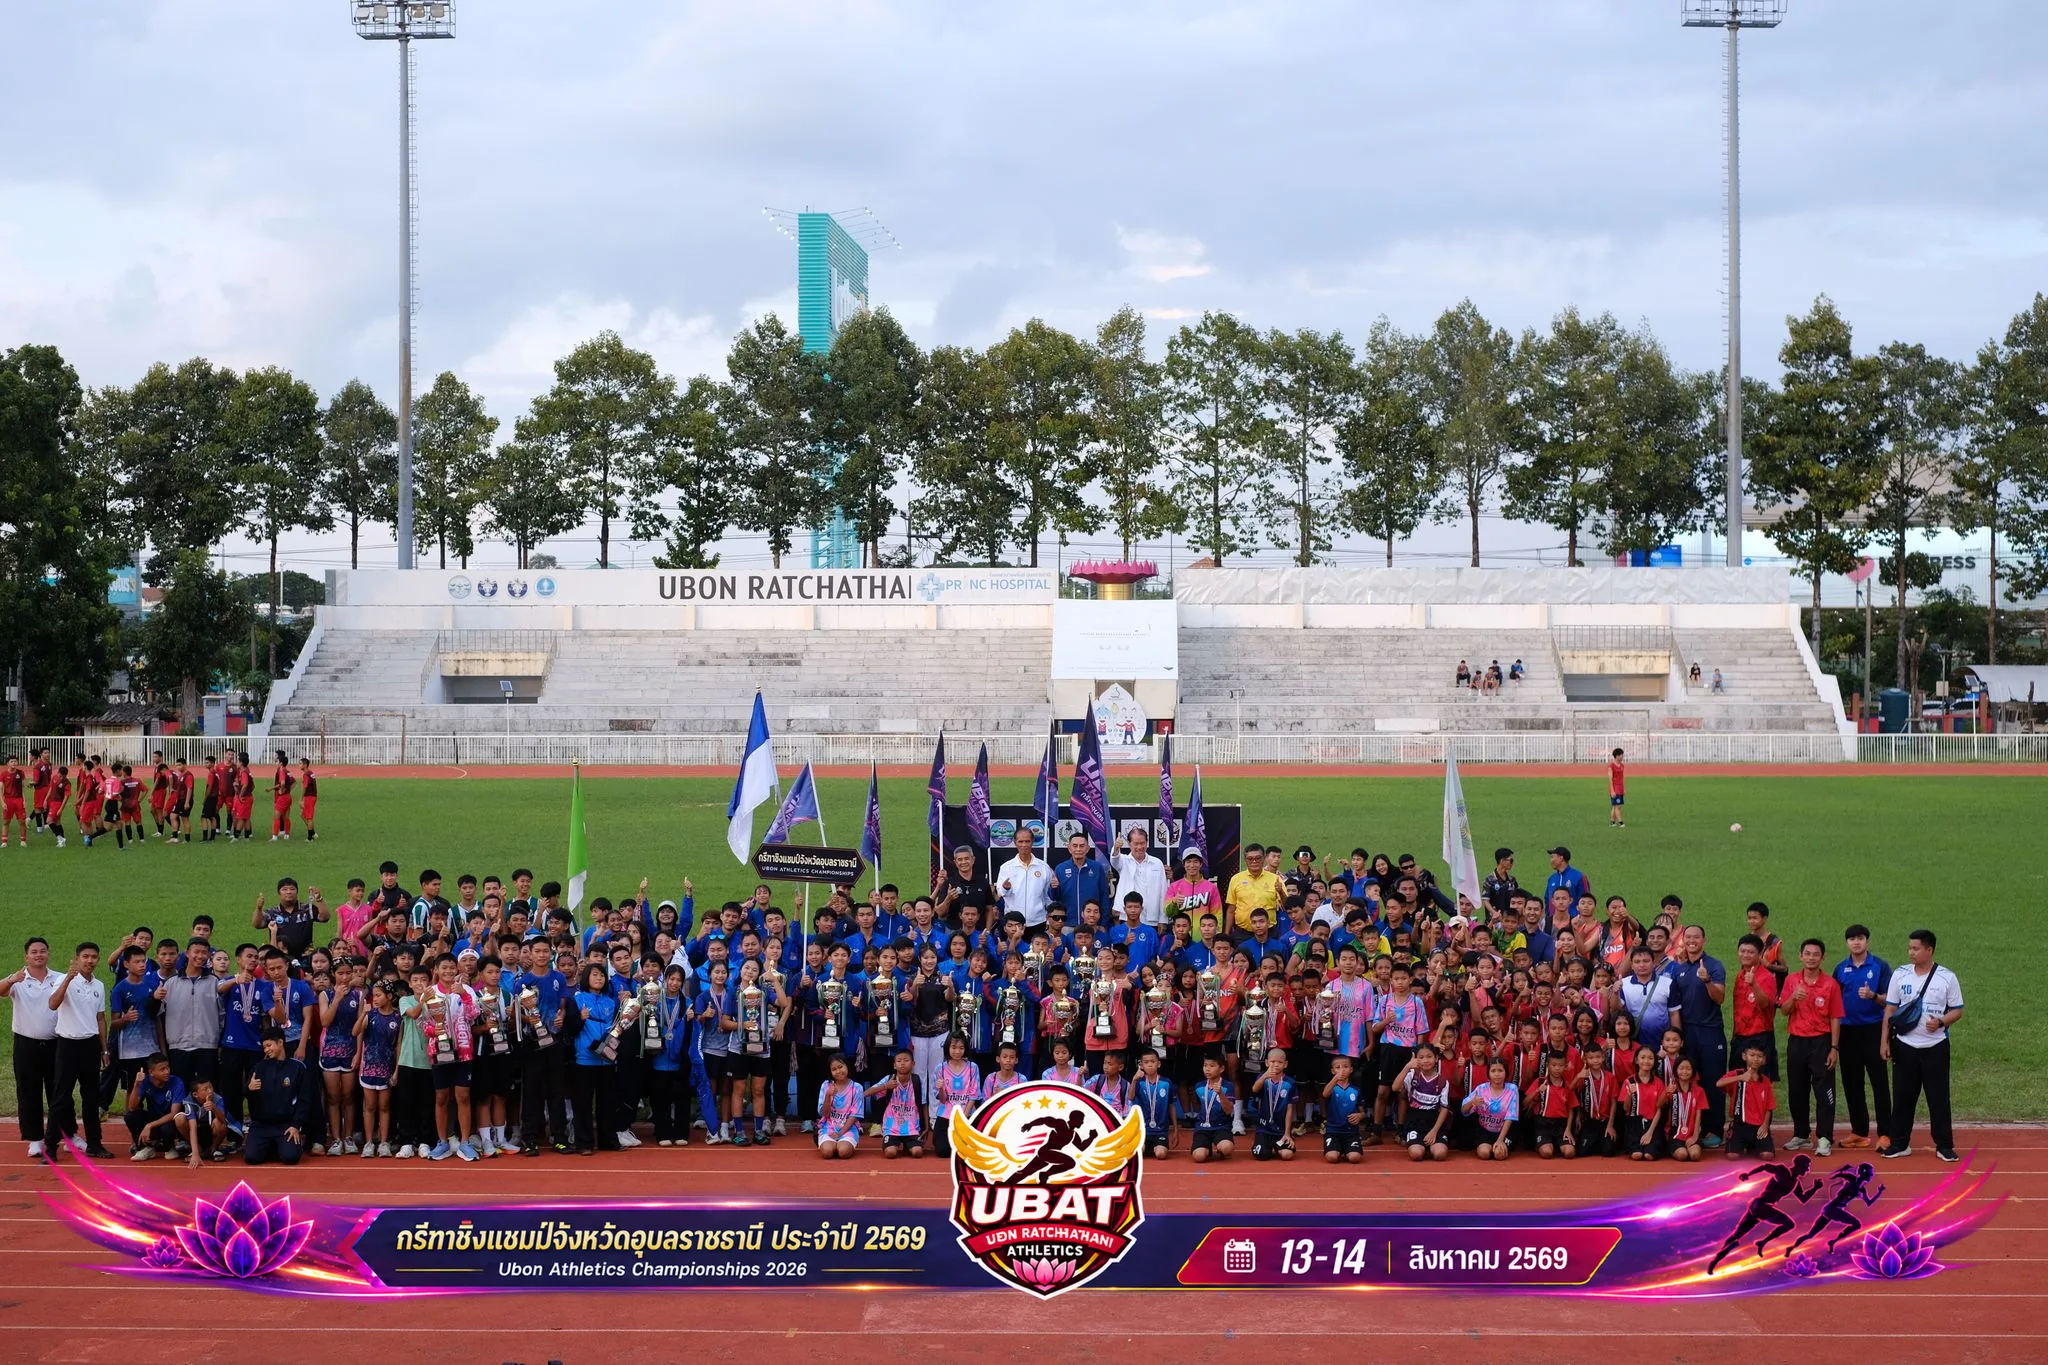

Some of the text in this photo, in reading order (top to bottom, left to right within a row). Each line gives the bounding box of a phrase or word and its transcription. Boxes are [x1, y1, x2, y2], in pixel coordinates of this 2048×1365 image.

[659, 575, 736, 600] UBON
[990, 579, 1050, 591] HOSPITAL
[810, 869, 854, 877] CHAMPIONSHIPS
[1604, 944, 1624, 955] KNP
